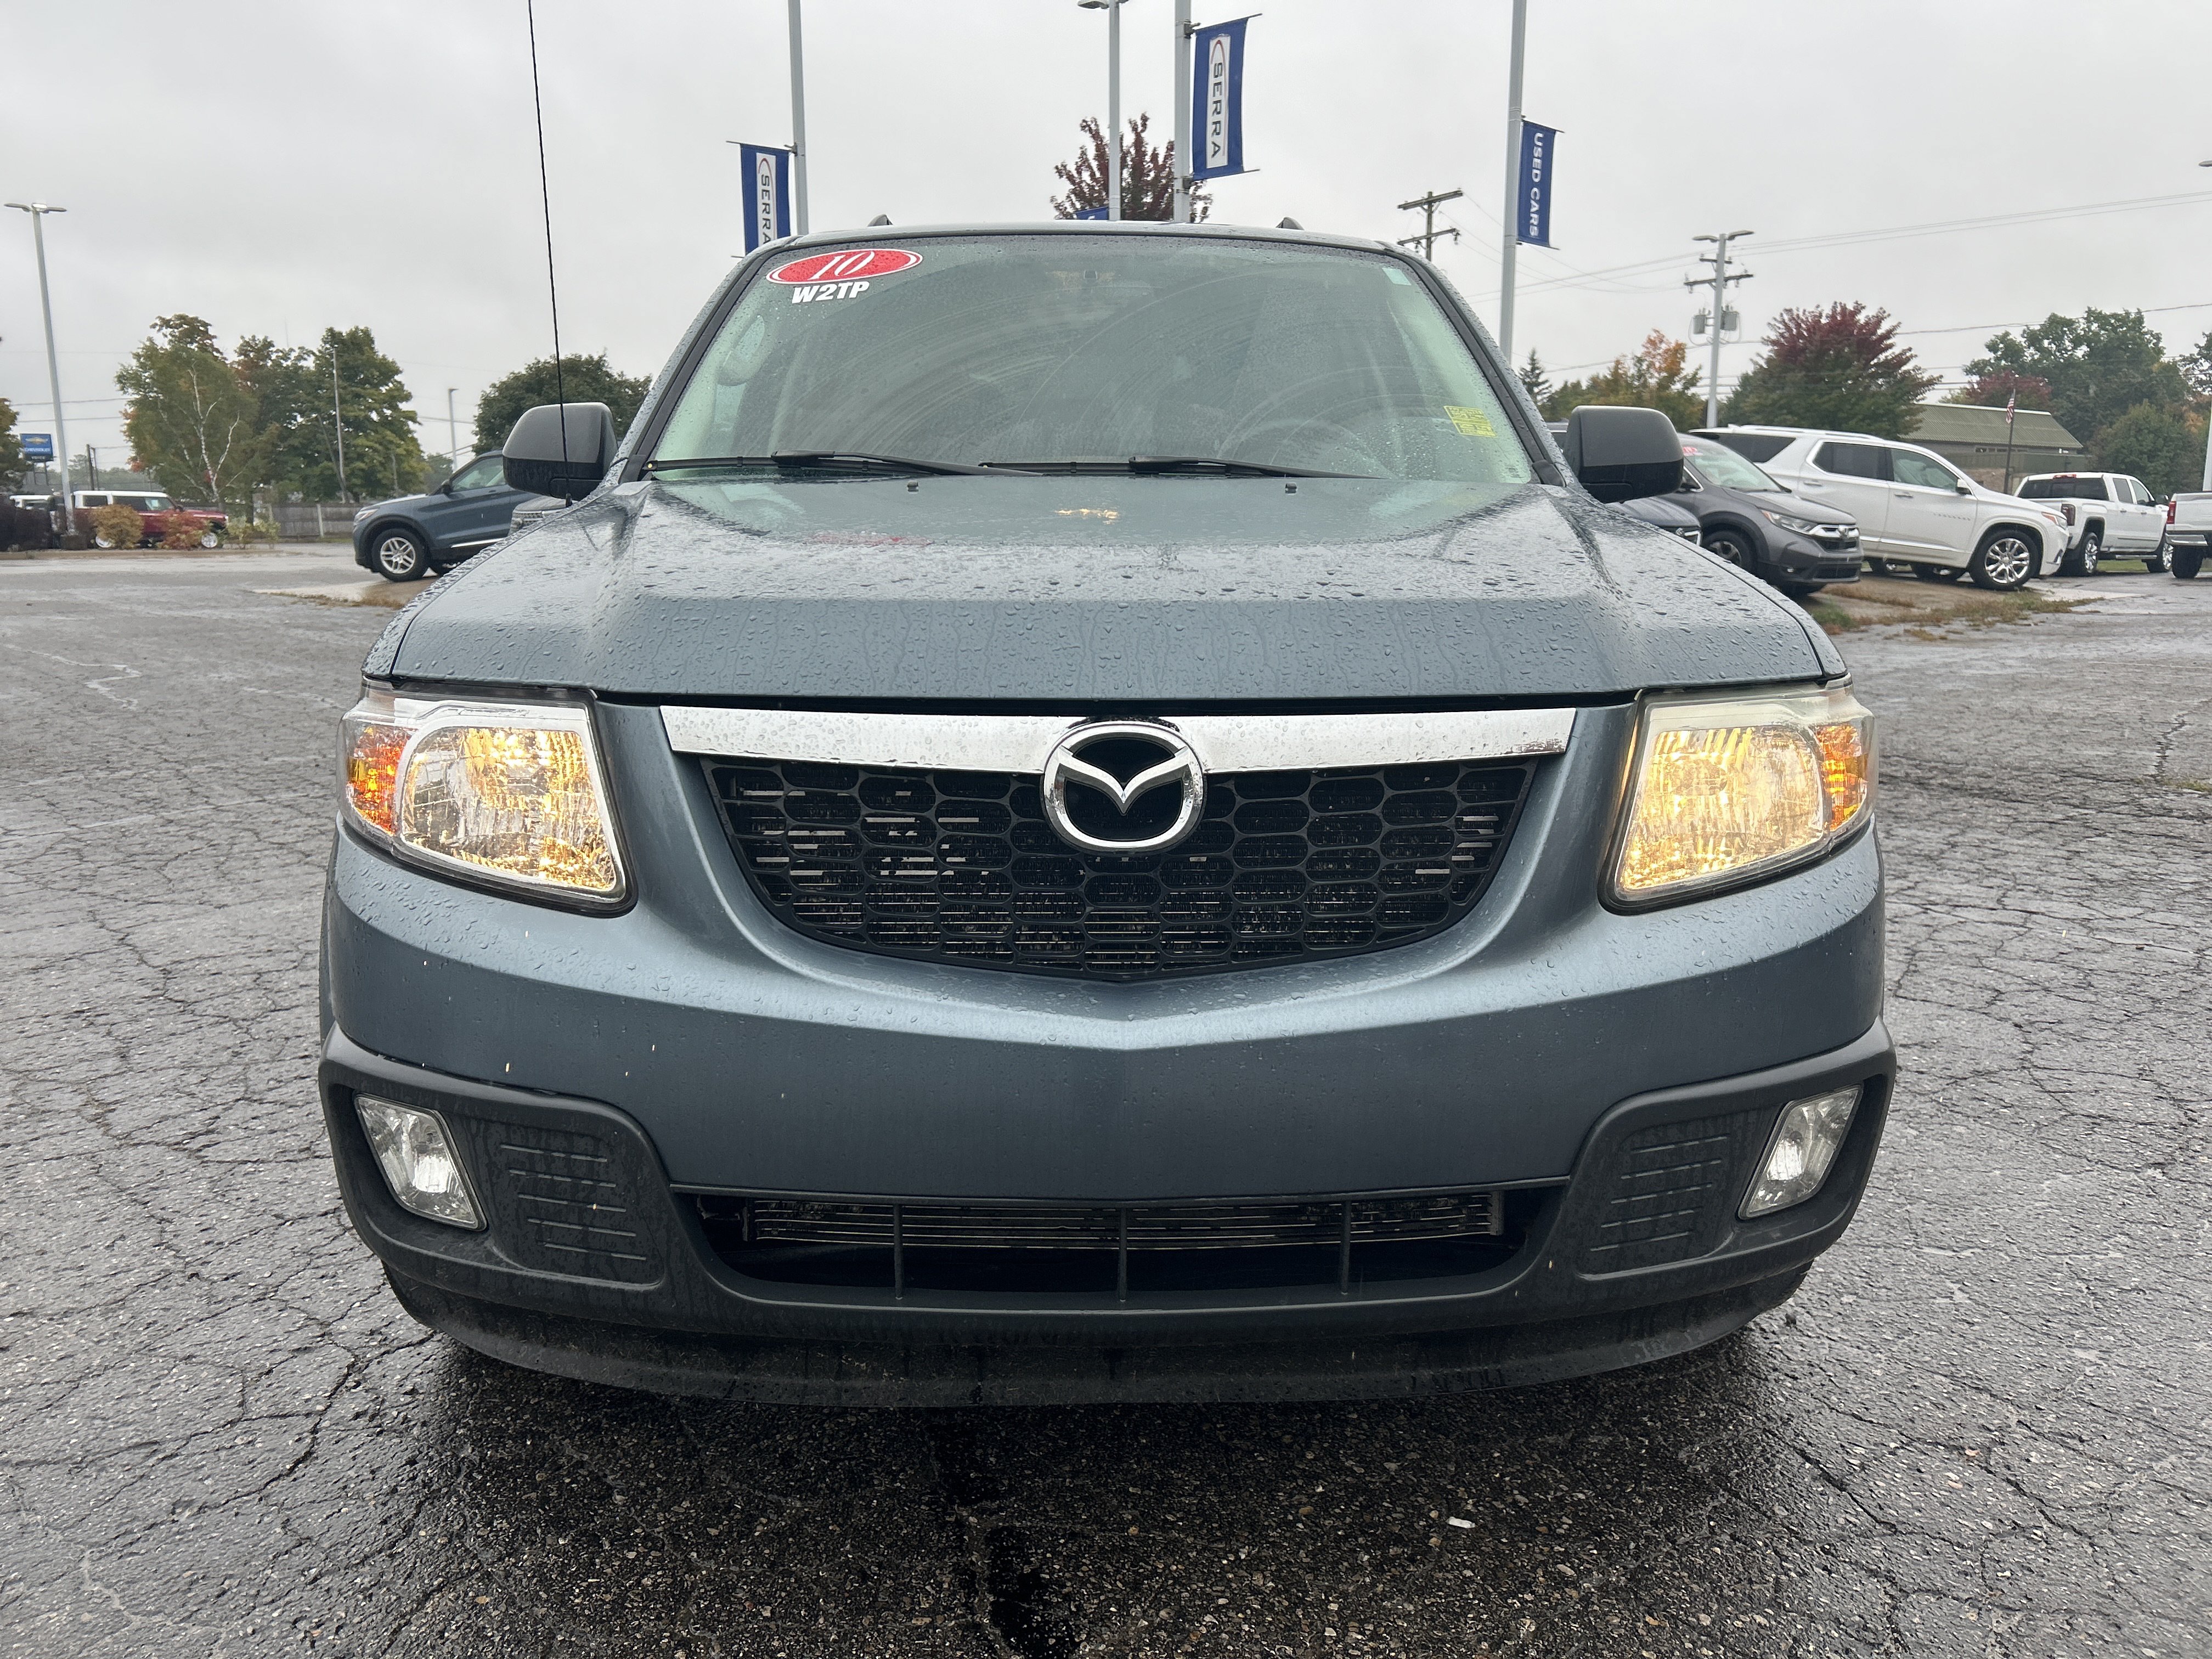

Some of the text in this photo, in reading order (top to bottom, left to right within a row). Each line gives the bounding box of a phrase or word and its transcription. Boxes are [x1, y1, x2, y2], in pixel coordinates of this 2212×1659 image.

[1211, 63, 1223, 158] SERRA
[761, 174, 771, 244] SERRA
[1530, 133, 1544, 236] USED CARS
[792, 281, 870, 303] W2TP
[807, 251, 875, 280] 10
